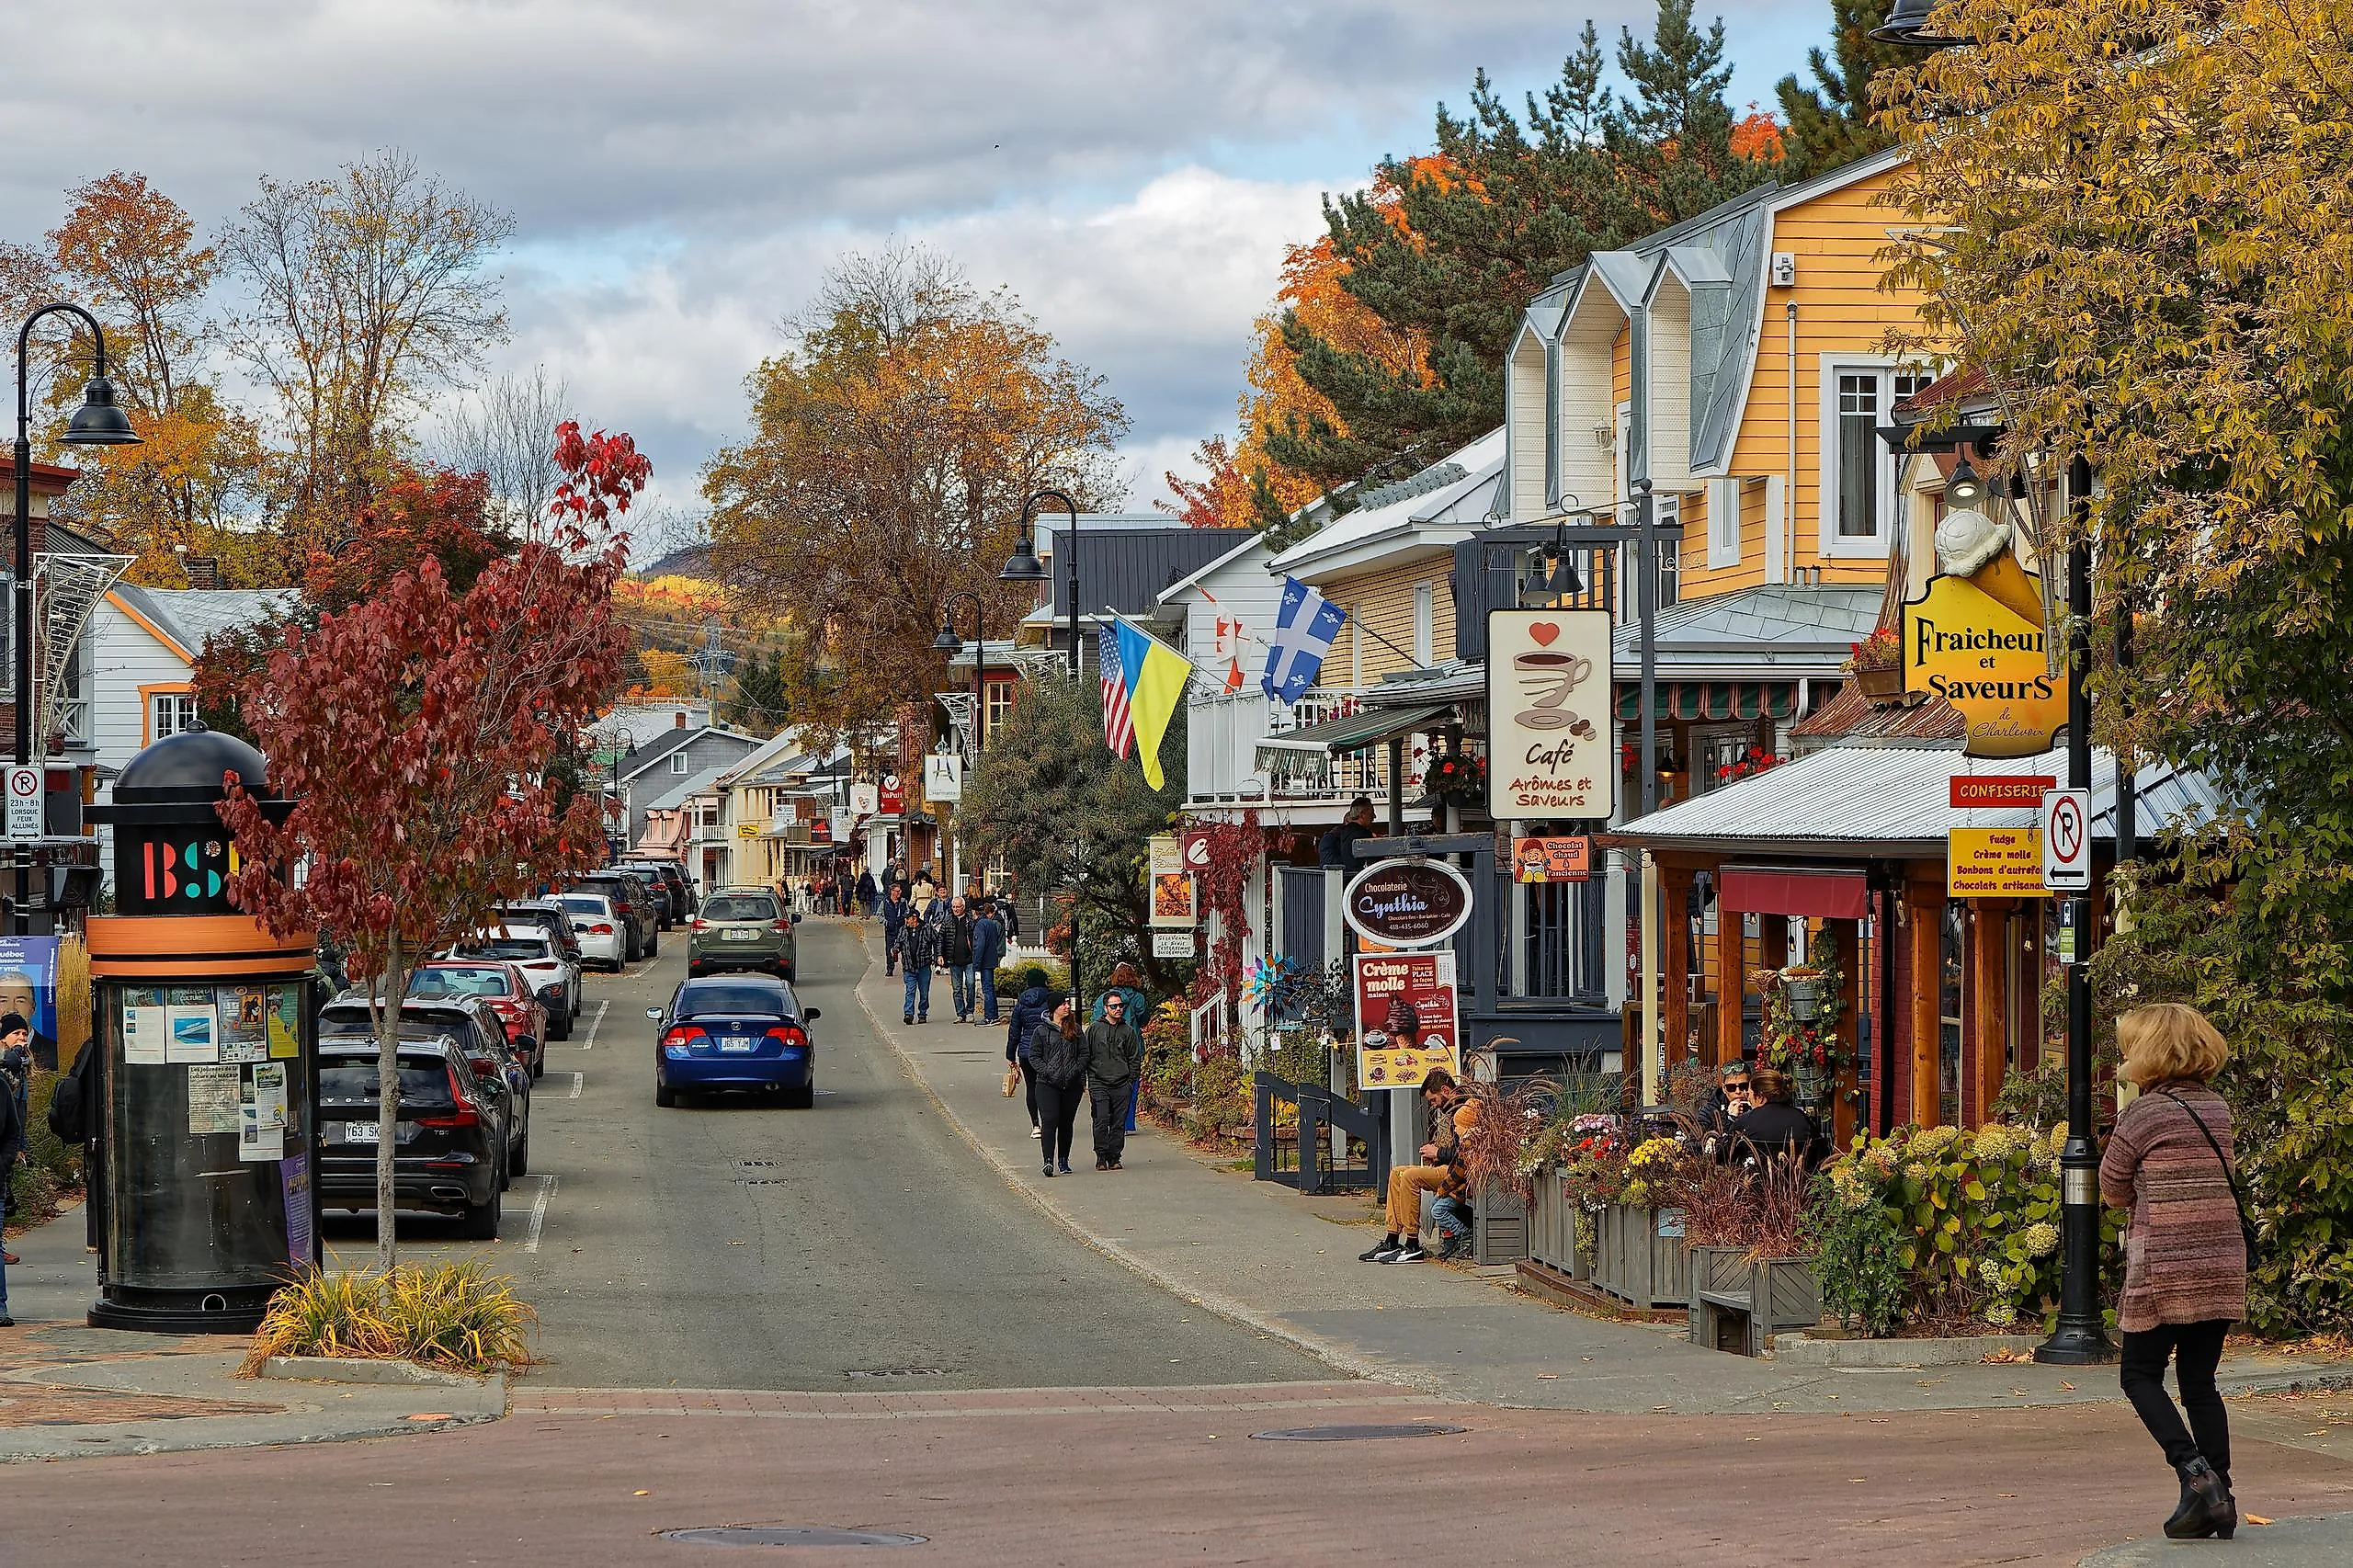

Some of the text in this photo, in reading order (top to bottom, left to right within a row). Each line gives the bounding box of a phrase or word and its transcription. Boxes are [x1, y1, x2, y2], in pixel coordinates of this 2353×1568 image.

[1979, 655, 1996, 669] et
[1998, 706, 2012, 721] de
[1972, 721, 2045, 738] Charlevoix
[1525, 738, 1575, 775] Café
[1508, 774, 1592, 791] Arômes et
[1960, 784, 2048, 799] CONFISERIE
[1989, 835, 2016, 846] Fudge
[1973, 849, 2031, 859] Crème molle
[1957, 865, 2043, 874] Bonbons d'autrefoi
[1364, 881, 1408, 893] Chocolaterie
[1953, 880, 1997, 891] Chocolats
[1358, 893, 1428, 919] Cynthia
[1389, 921, 1429, 930] 418-435-6060
[0, 949, 25, 958] uébec
[1362, 960, 1409, 977] Crème
[1412, 970, 1434, 978] PLACE
[1366, 976, 1406, 993] molle
[1415, 999, 1440, 1010] Cynthia
[369, 1125, 381, 1137] SK
